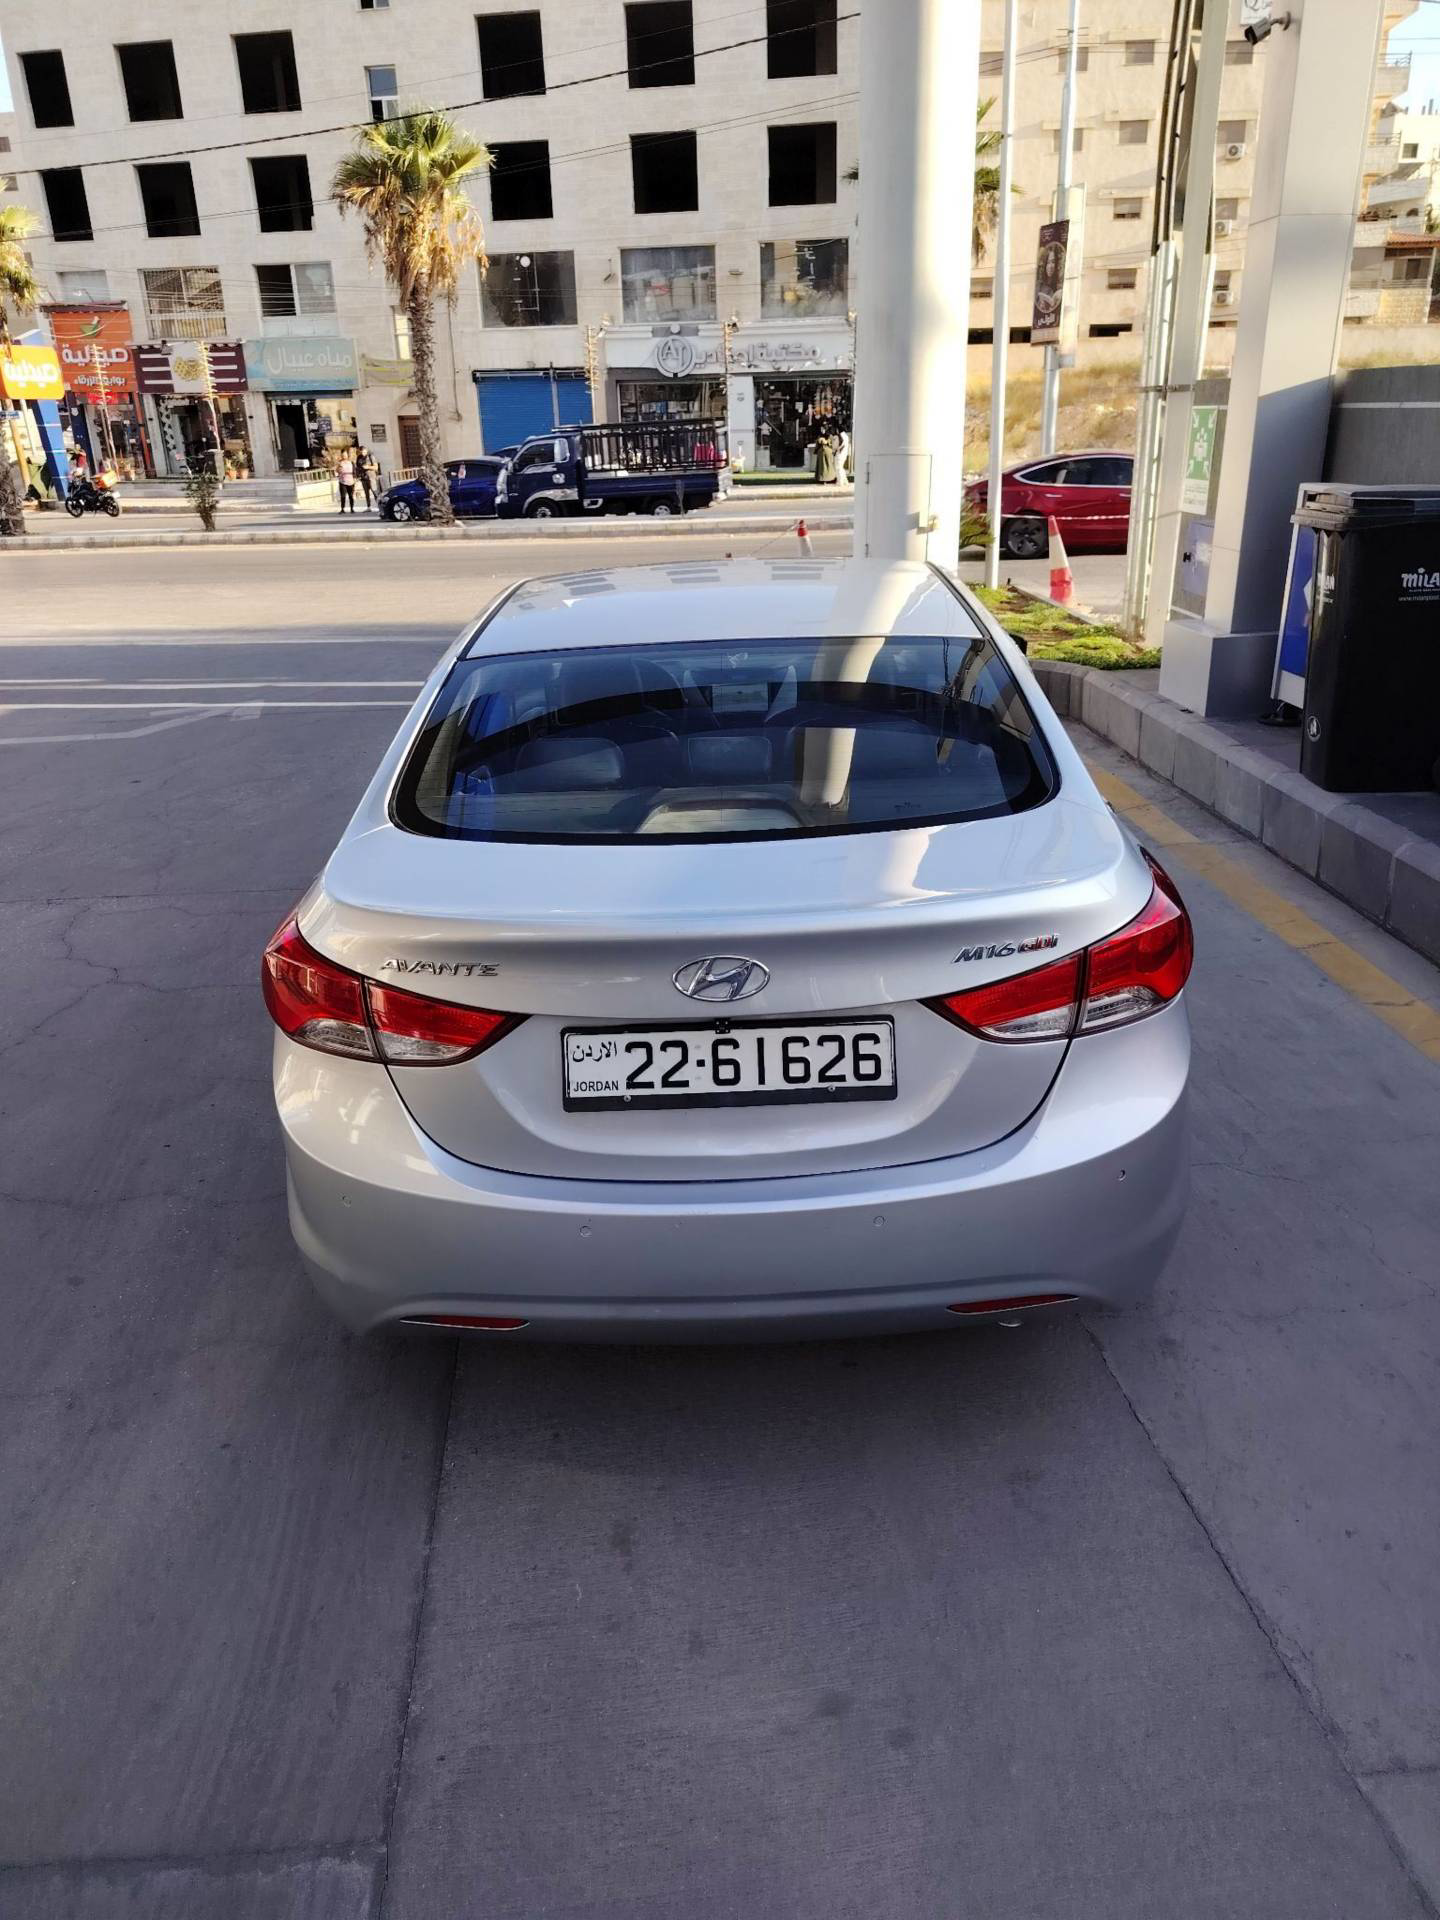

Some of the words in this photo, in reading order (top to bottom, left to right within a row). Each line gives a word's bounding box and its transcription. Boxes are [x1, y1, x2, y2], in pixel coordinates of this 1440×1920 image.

[62, 343, 128, 368] صيدلية
[317, 346, 352, 370] مياه
[758, 343, 820, 364] مكتبة
[952, 942, 1016, 963] M16
[381, 959, 500, 977] AVANTE
[573, 1080, 619, 1093] JORDAN
